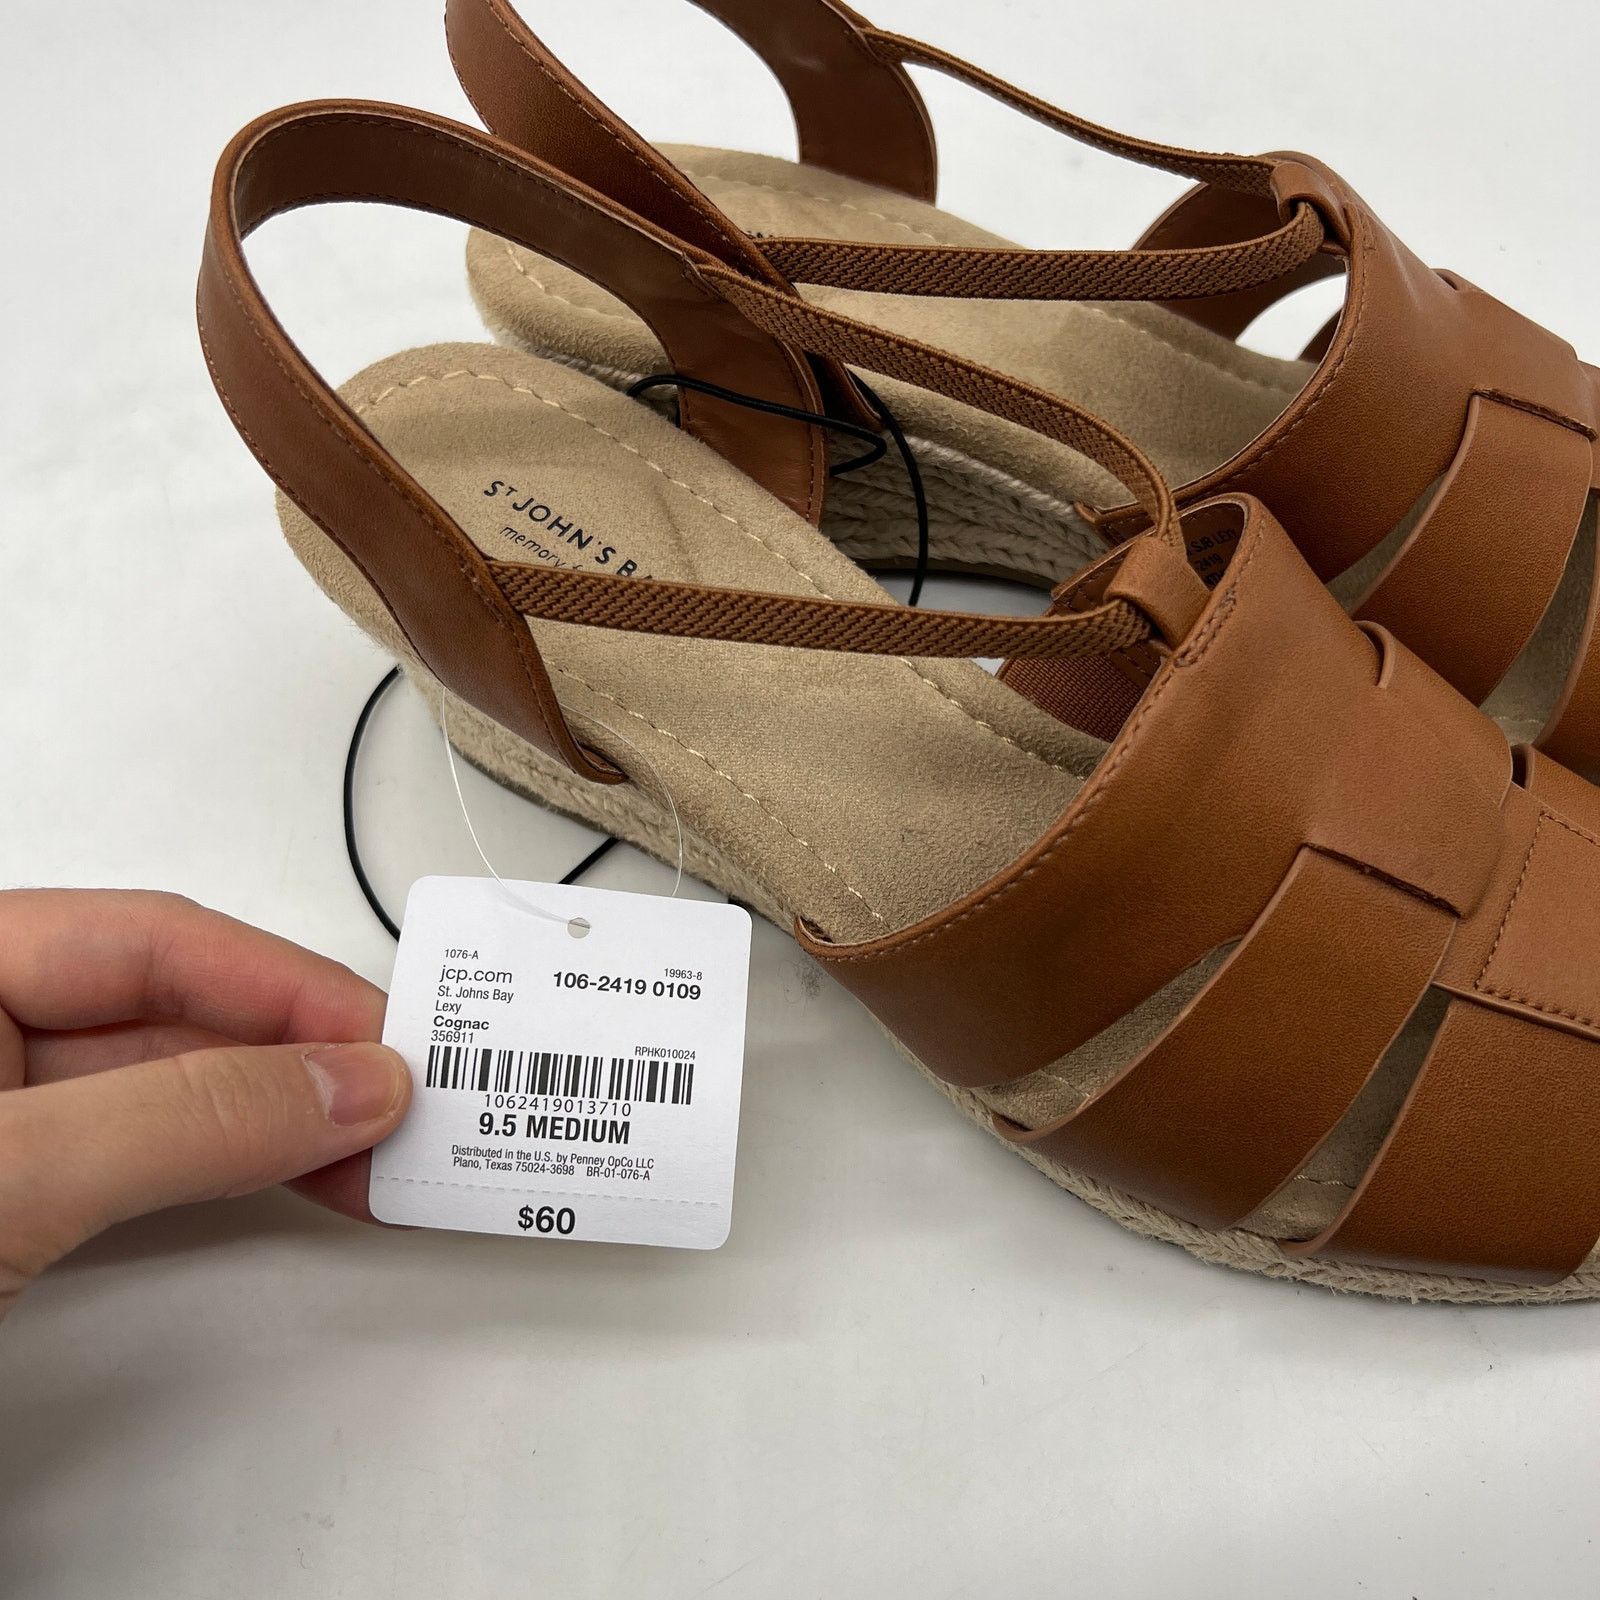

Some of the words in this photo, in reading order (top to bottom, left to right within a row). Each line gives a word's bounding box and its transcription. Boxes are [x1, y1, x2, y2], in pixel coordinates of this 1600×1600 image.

[444, 949, 479, 960] 1076-A
[439, 965, 513, 984] jcp.com
[664, 968, 703, 981] 19963-8
[437, 985, 452, 997] St.
[455, 987, 489, 1000] Johns
[492, 989, 514, 1003] Bay
[553, 971, 647, 995] 106-2419
[652, 981, 701, 1000] 0109
[435, 1000, 462, 1014] Lexy
[433, 1015, 490, 1031] Cognac
[430, 1029, 474, 1044] 356911
[634, 1046, 696, 1060] RPHK010024
[484, 1094, 632, 1117] 1062419013710
[478, 1112, 517, 1137] 9.5
[525, 1115, 630, 1145] MEDIUM
[451, 1144, 502, 1157] Distributed
[505, 1149, 514, 1159] in
[516, 1149, 532, 1160] the
[534, 1151, 552, 1162] U.S.
[556, 1153, 568, 1165] by
[570, 1155, 606, 1168] Penney
[607, 1156, 633, 1168] OpCo
[635, 1158, 655, 1169] LLC
[453, 1157, 481, 1170] Plano,
[485, 1159, 512, 1171] Texas
[515, 1161, 575, 1176] 75024-3698
[586, 1166, 651, 1181] BR-01-076-A
[517, 1204, 576, 1235] $60
